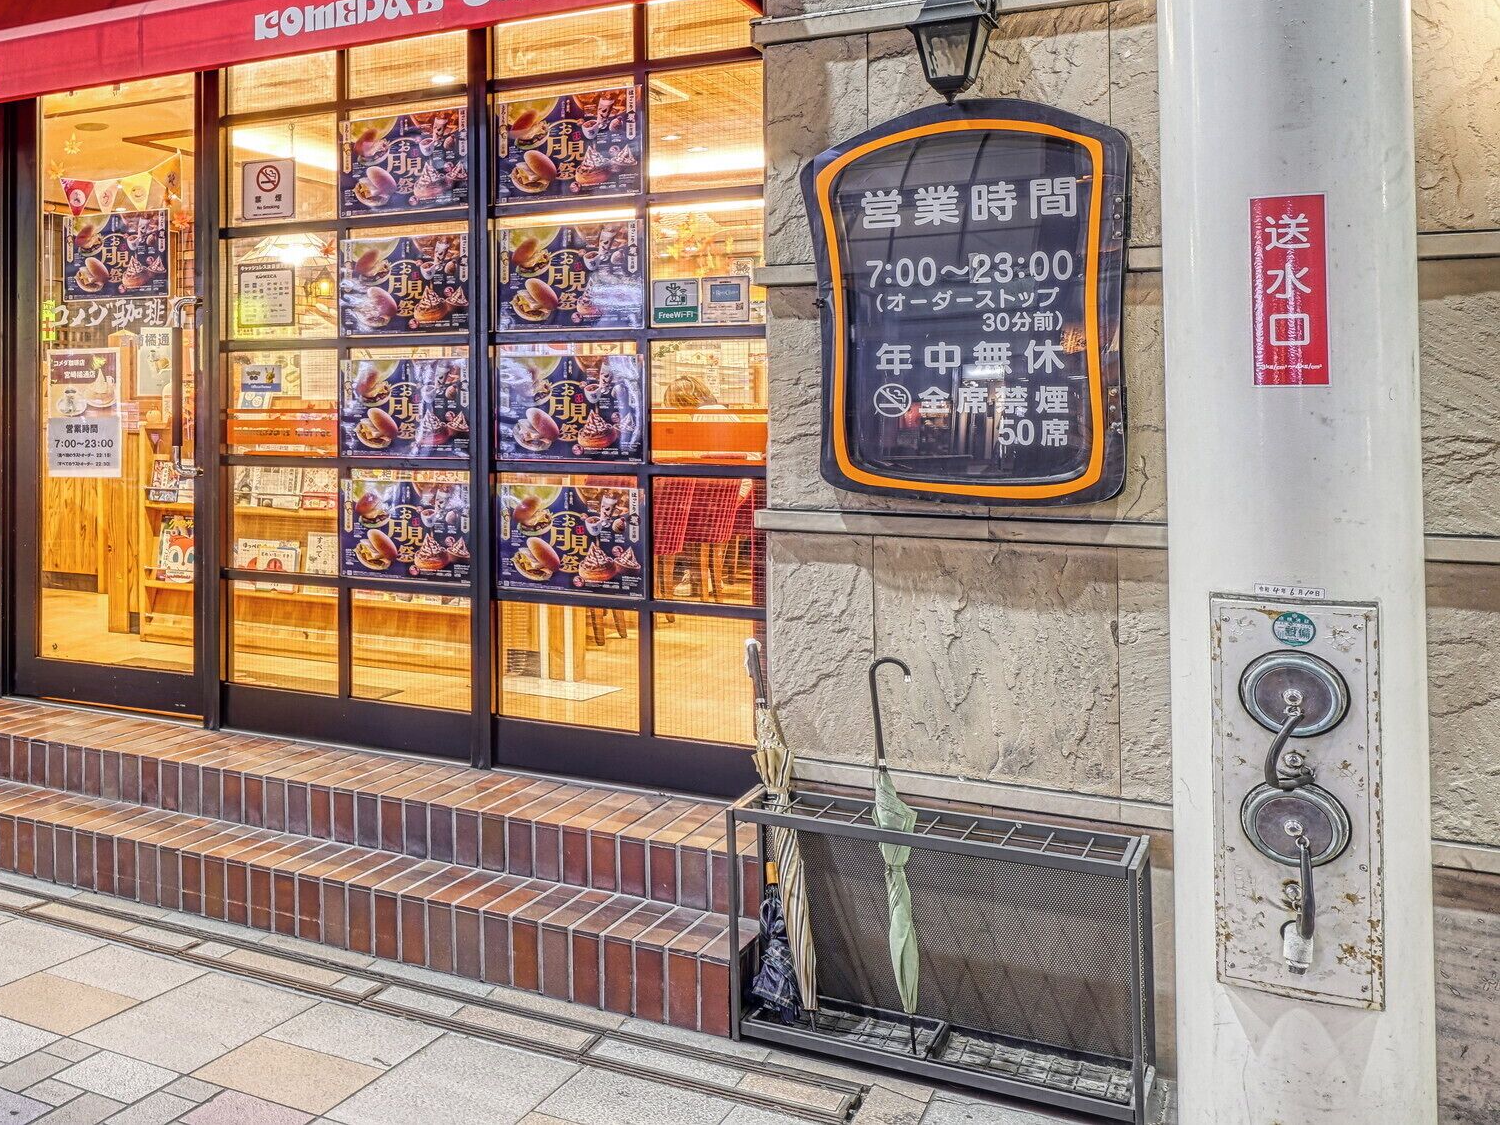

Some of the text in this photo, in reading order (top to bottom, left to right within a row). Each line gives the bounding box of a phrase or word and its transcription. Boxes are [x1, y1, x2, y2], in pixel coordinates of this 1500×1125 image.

[860, 176, 1078, 230] 営業時間
[1265, 213, 1312, 346] 送水口
[982, 311, 1065, 333] 30分前)
[875, 340, 1066, 376] 年中無休
[917, 382, 1070, 416] 全席禁煙
[65, 424, 99, 434] 営業時間
[998, 418, 1070, 447] 50席
